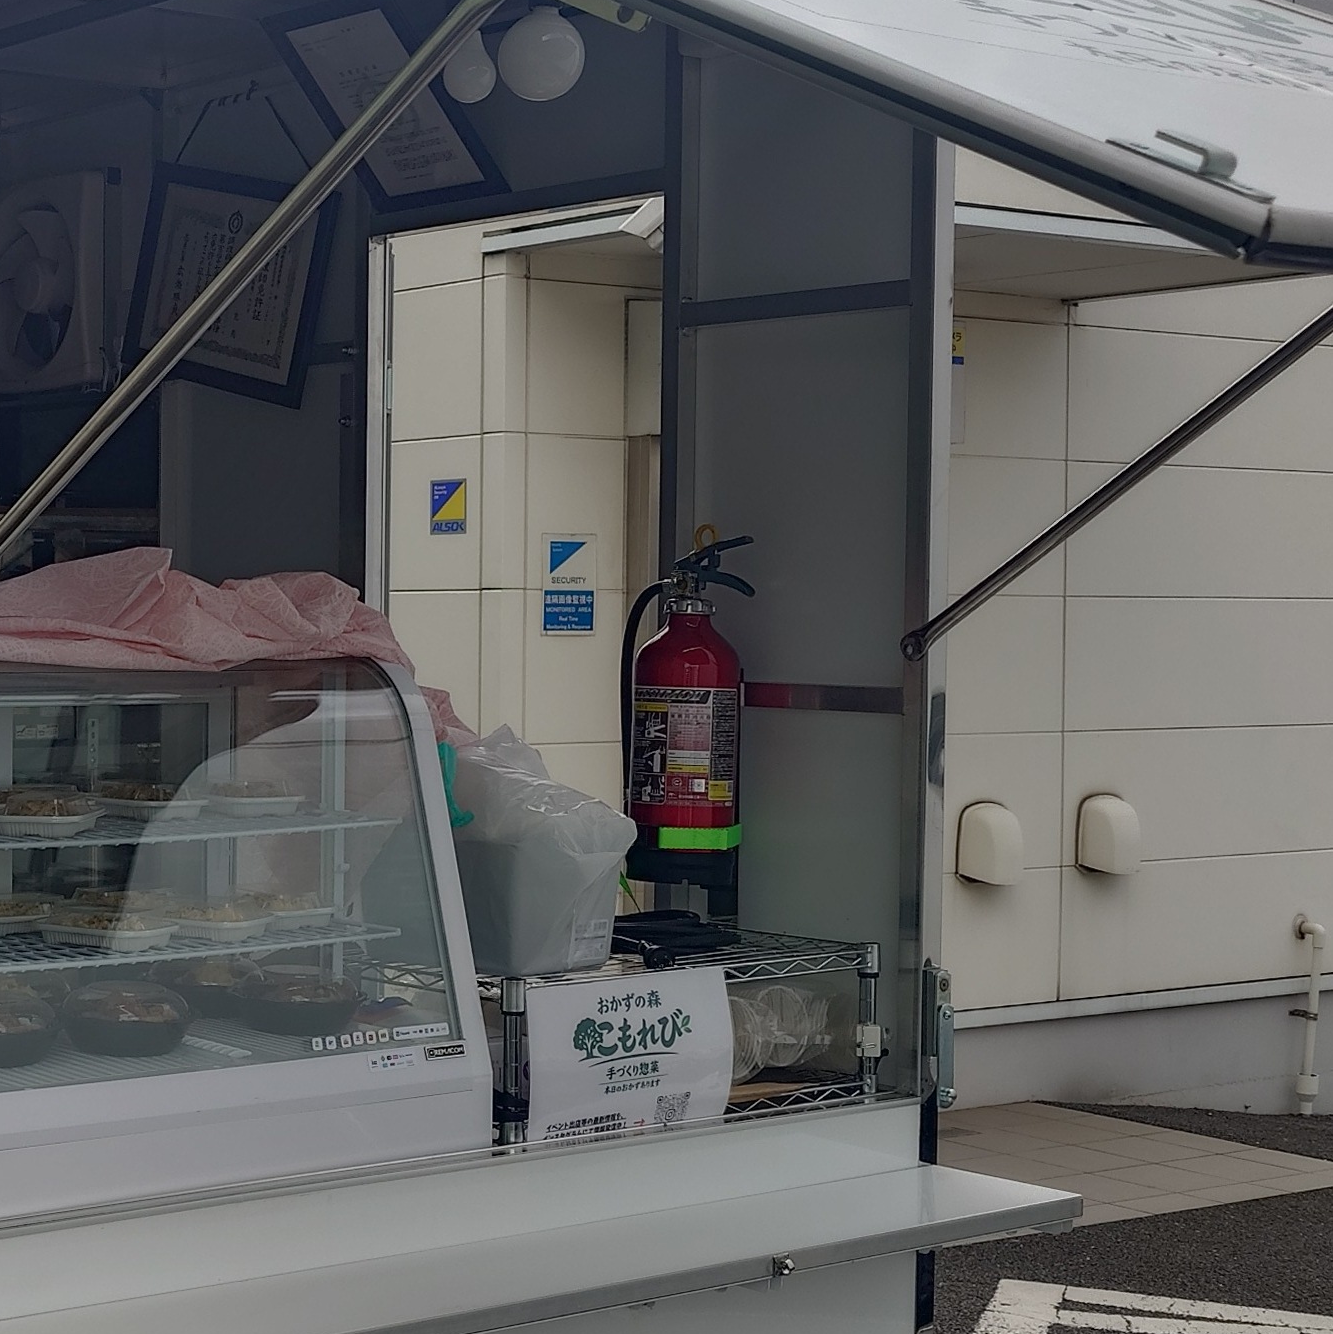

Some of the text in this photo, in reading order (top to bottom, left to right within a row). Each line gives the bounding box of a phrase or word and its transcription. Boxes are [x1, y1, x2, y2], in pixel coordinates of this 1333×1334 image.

[432, 521, 465, 532] ALSOK
[551, 576, 587, 584] SECURITY
[597, 989, 662, 1015] おかずの森
[597, 1008, 684, 1056] こもれび
[605, 1061, 660, 1081] 手づくり惣菜
